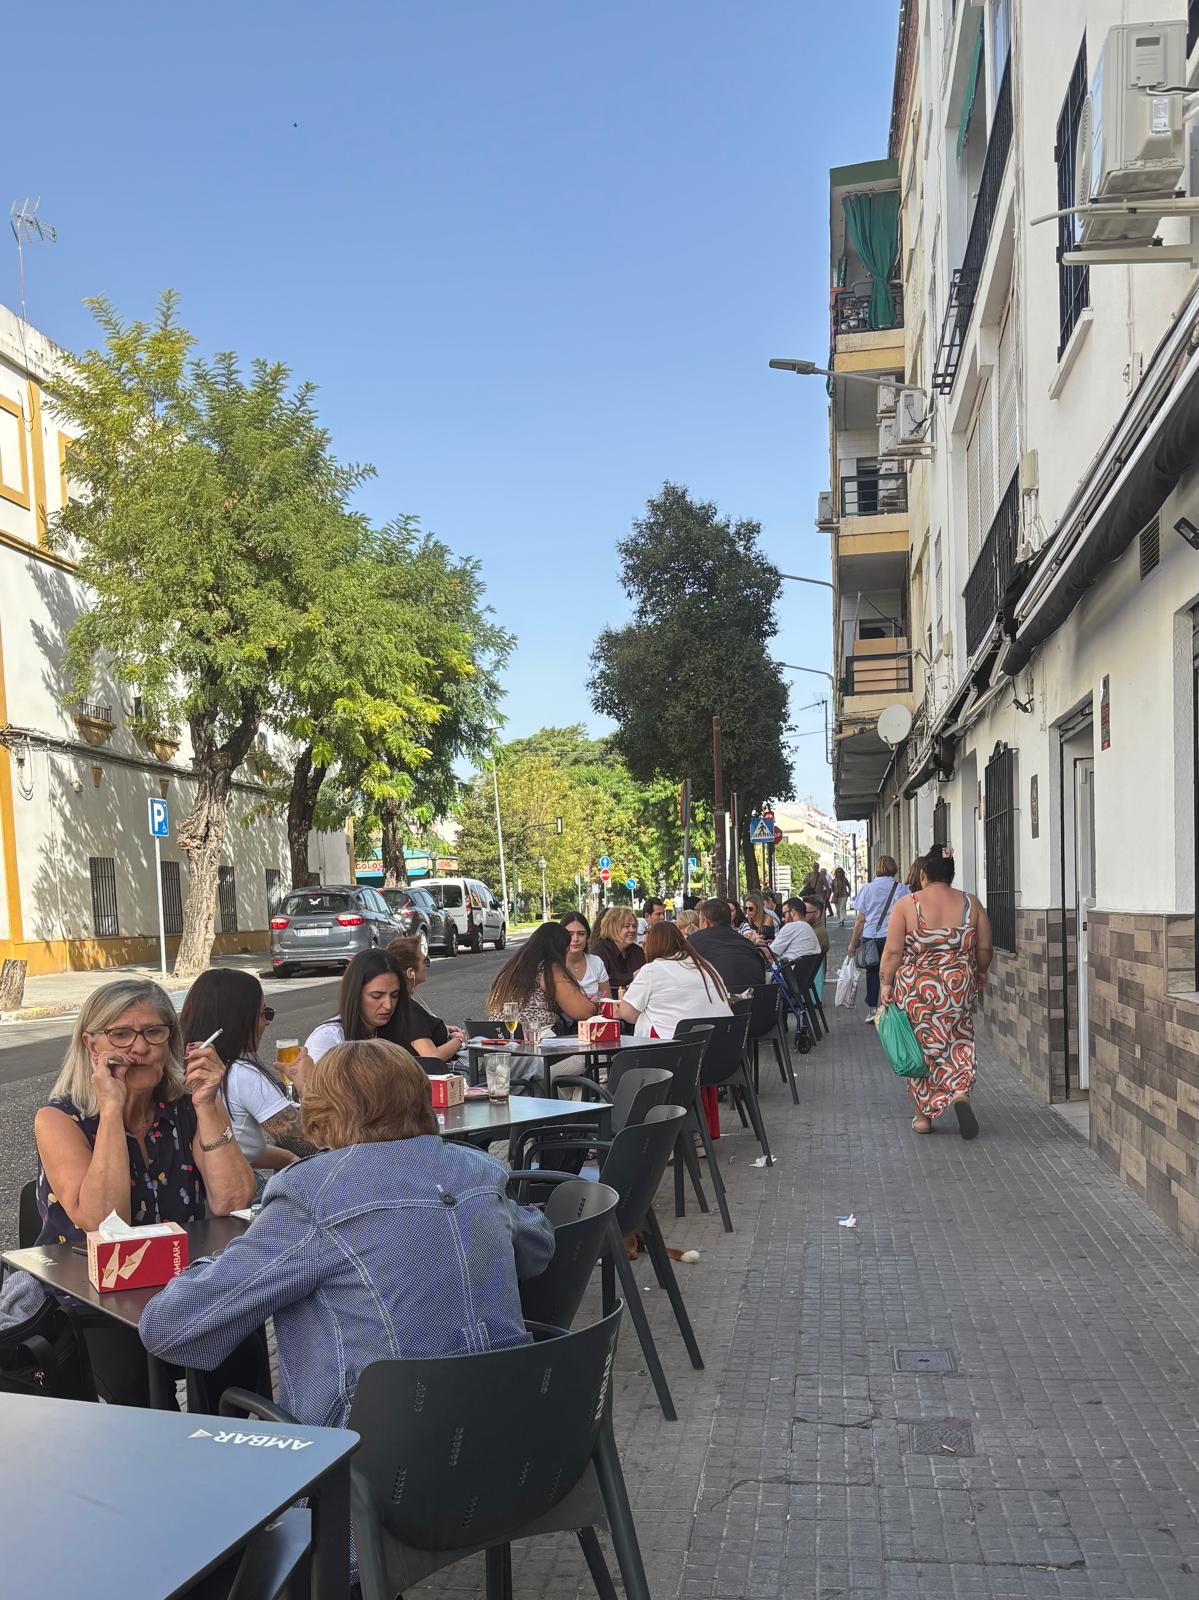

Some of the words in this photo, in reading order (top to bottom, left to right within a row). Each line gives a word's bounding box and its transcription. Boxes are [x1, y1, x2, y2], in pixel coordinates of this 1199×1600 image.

[154, 803, 164, 831] P
[172, 1246, 181, 1276] AMBAR
[213, 1431, 315, 1450] AMBAR
